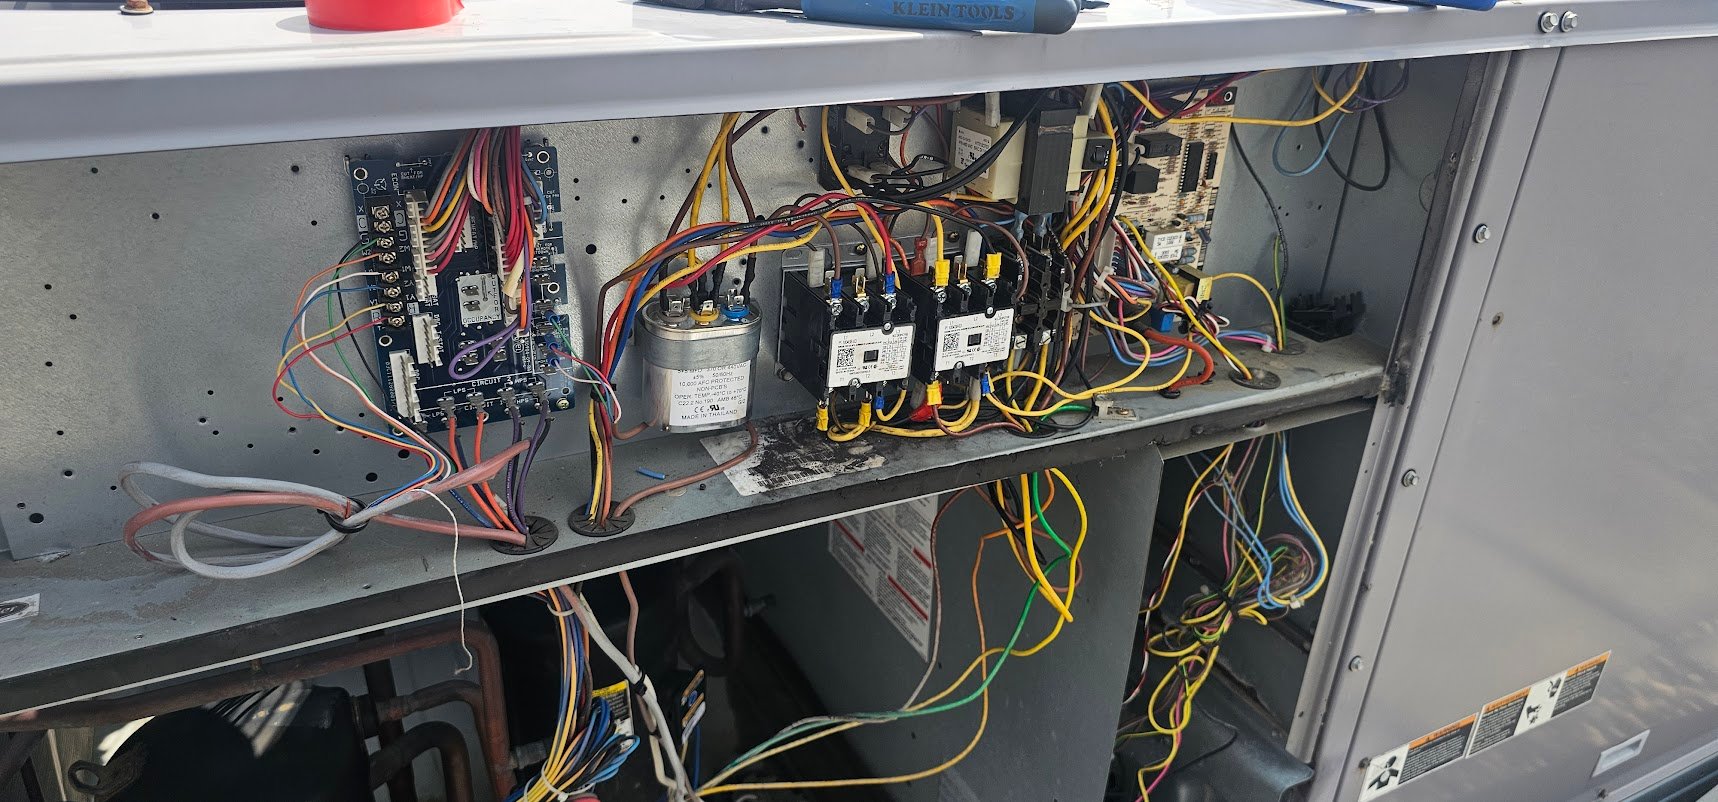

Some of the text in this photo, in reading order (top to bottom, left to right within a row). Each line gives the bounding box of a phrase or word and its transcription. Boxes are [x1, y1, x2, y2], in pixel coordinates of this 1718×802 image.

[892, 2, 1015, 20] KLEIN TOOLS
[391, 172, 399, 190] ECON
[471, 378, 501, 387] CIRCUIT
[710, 376, 744, 384] PROTECTED
